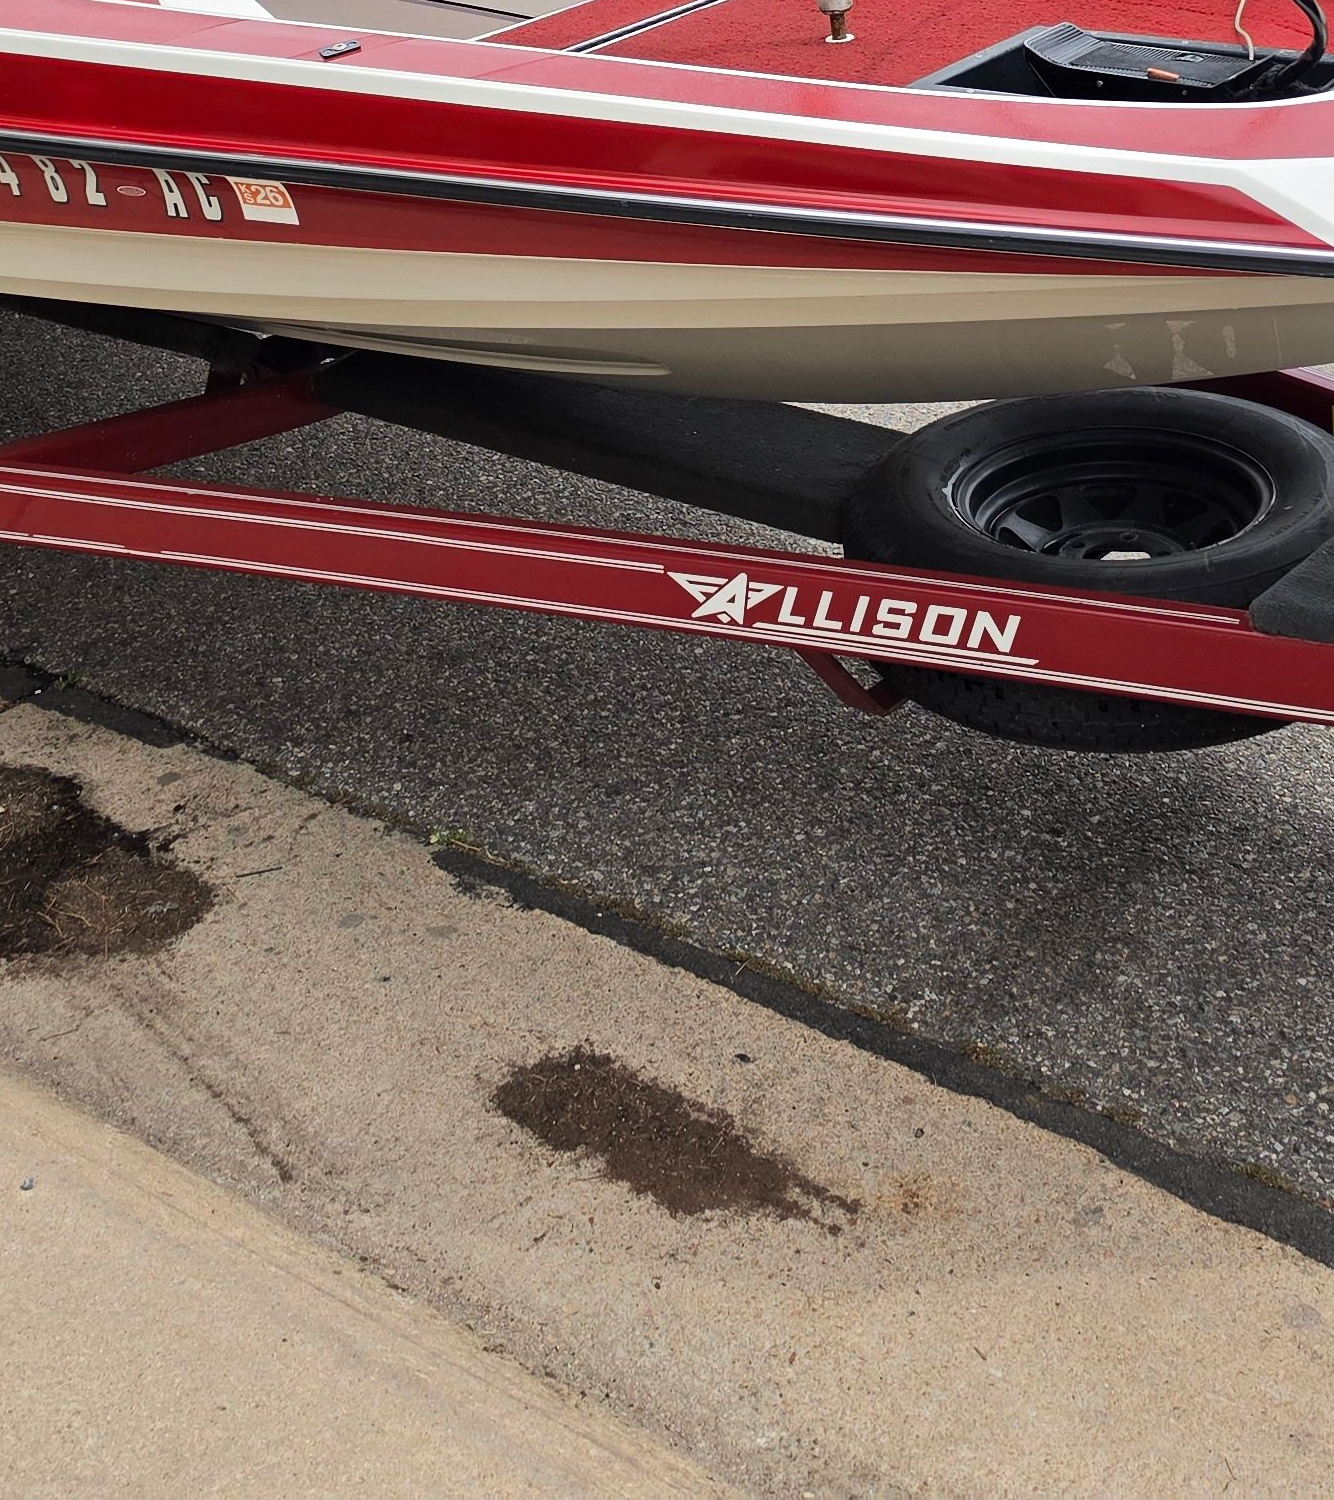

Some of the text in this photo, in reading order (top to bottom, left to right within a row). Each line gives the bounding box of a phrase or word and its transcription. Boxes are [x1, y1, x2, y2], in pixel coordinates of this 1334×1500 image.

[152, 167, 222, 221] AC
[251, 185, 284, 206] 26
[677, 572, 1022, 654] ALLISON
